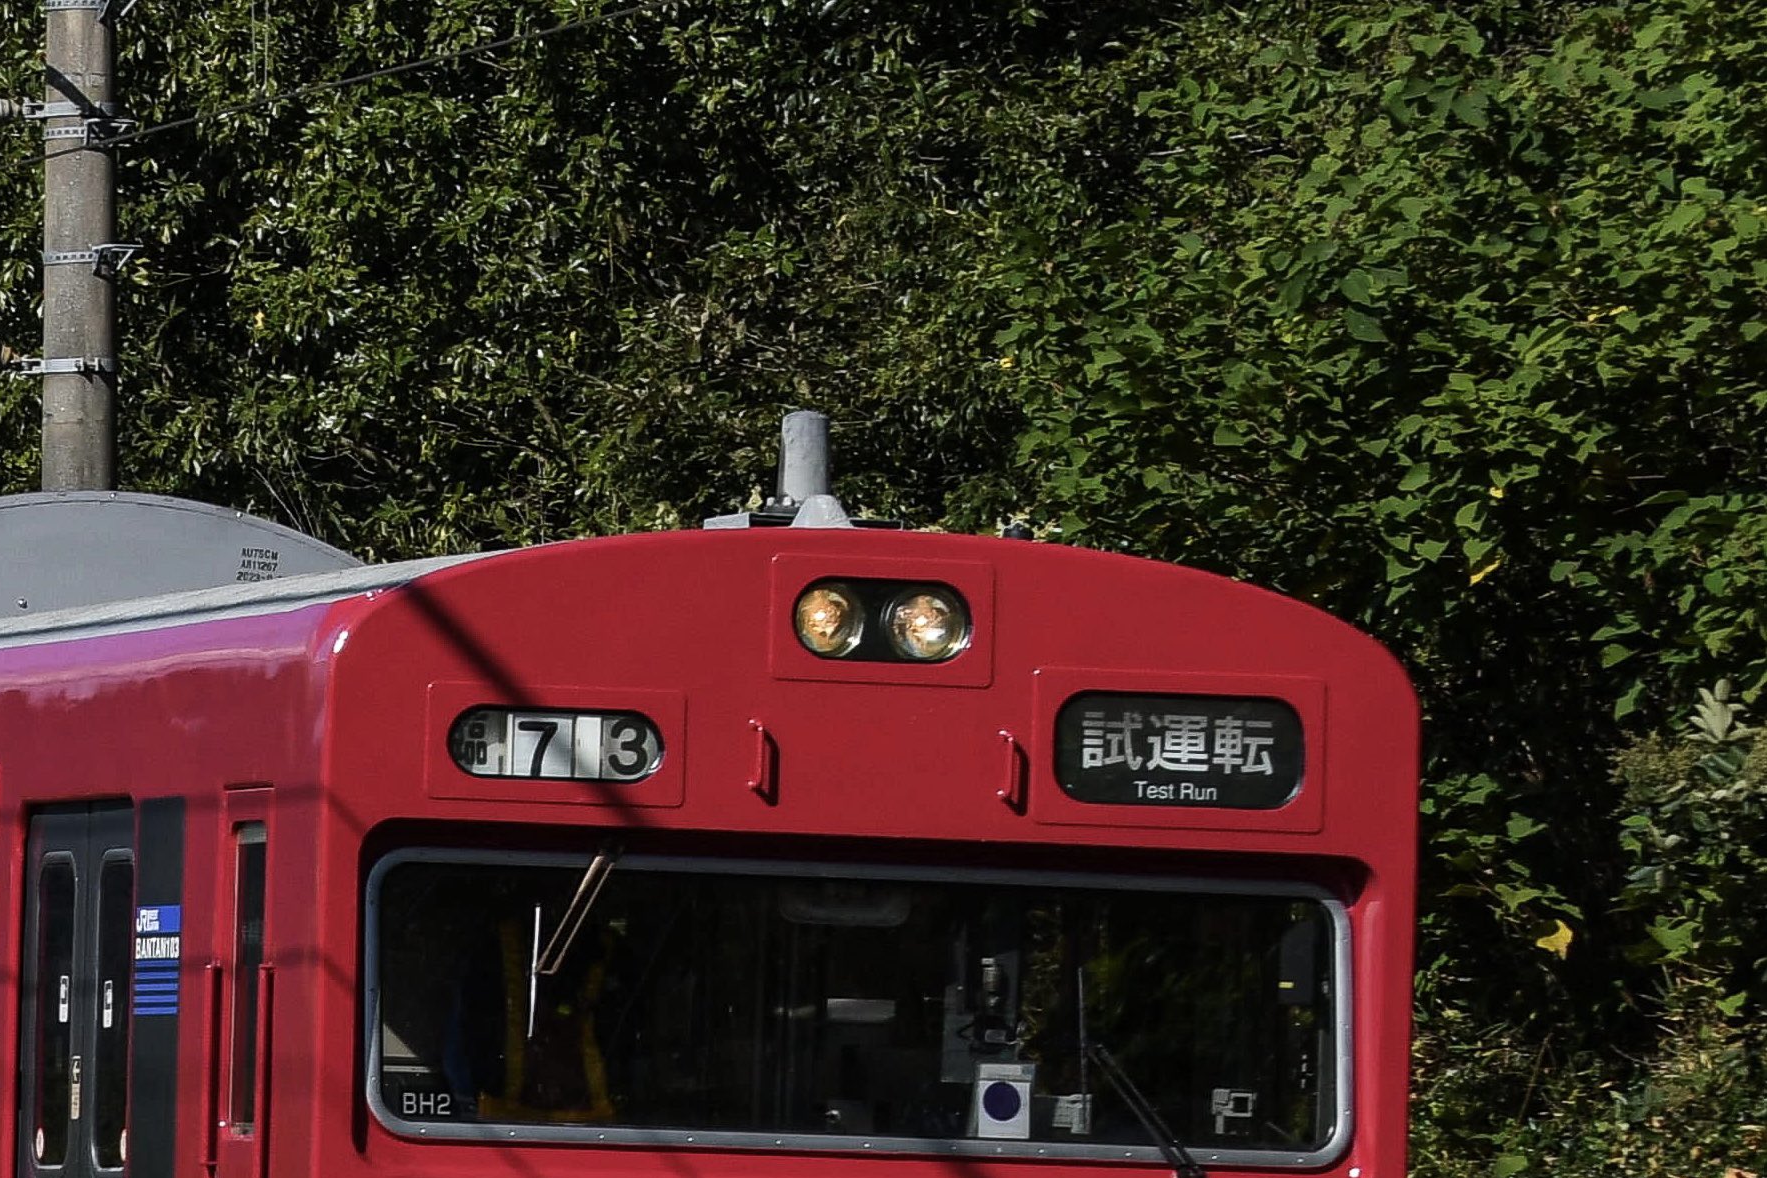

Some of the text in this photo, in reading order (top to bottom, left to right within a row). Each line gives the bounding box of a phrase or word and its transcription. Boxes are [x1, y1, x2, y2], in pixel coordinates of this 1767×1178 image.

[518, 720, 559, 777] 7
[608, 718, 648, 776] 3
[1081, 711, 1275, 776] 試運転
[1134, 781, 1218, 801] Test Run
[402, 1092, 451, 1115] BH2
